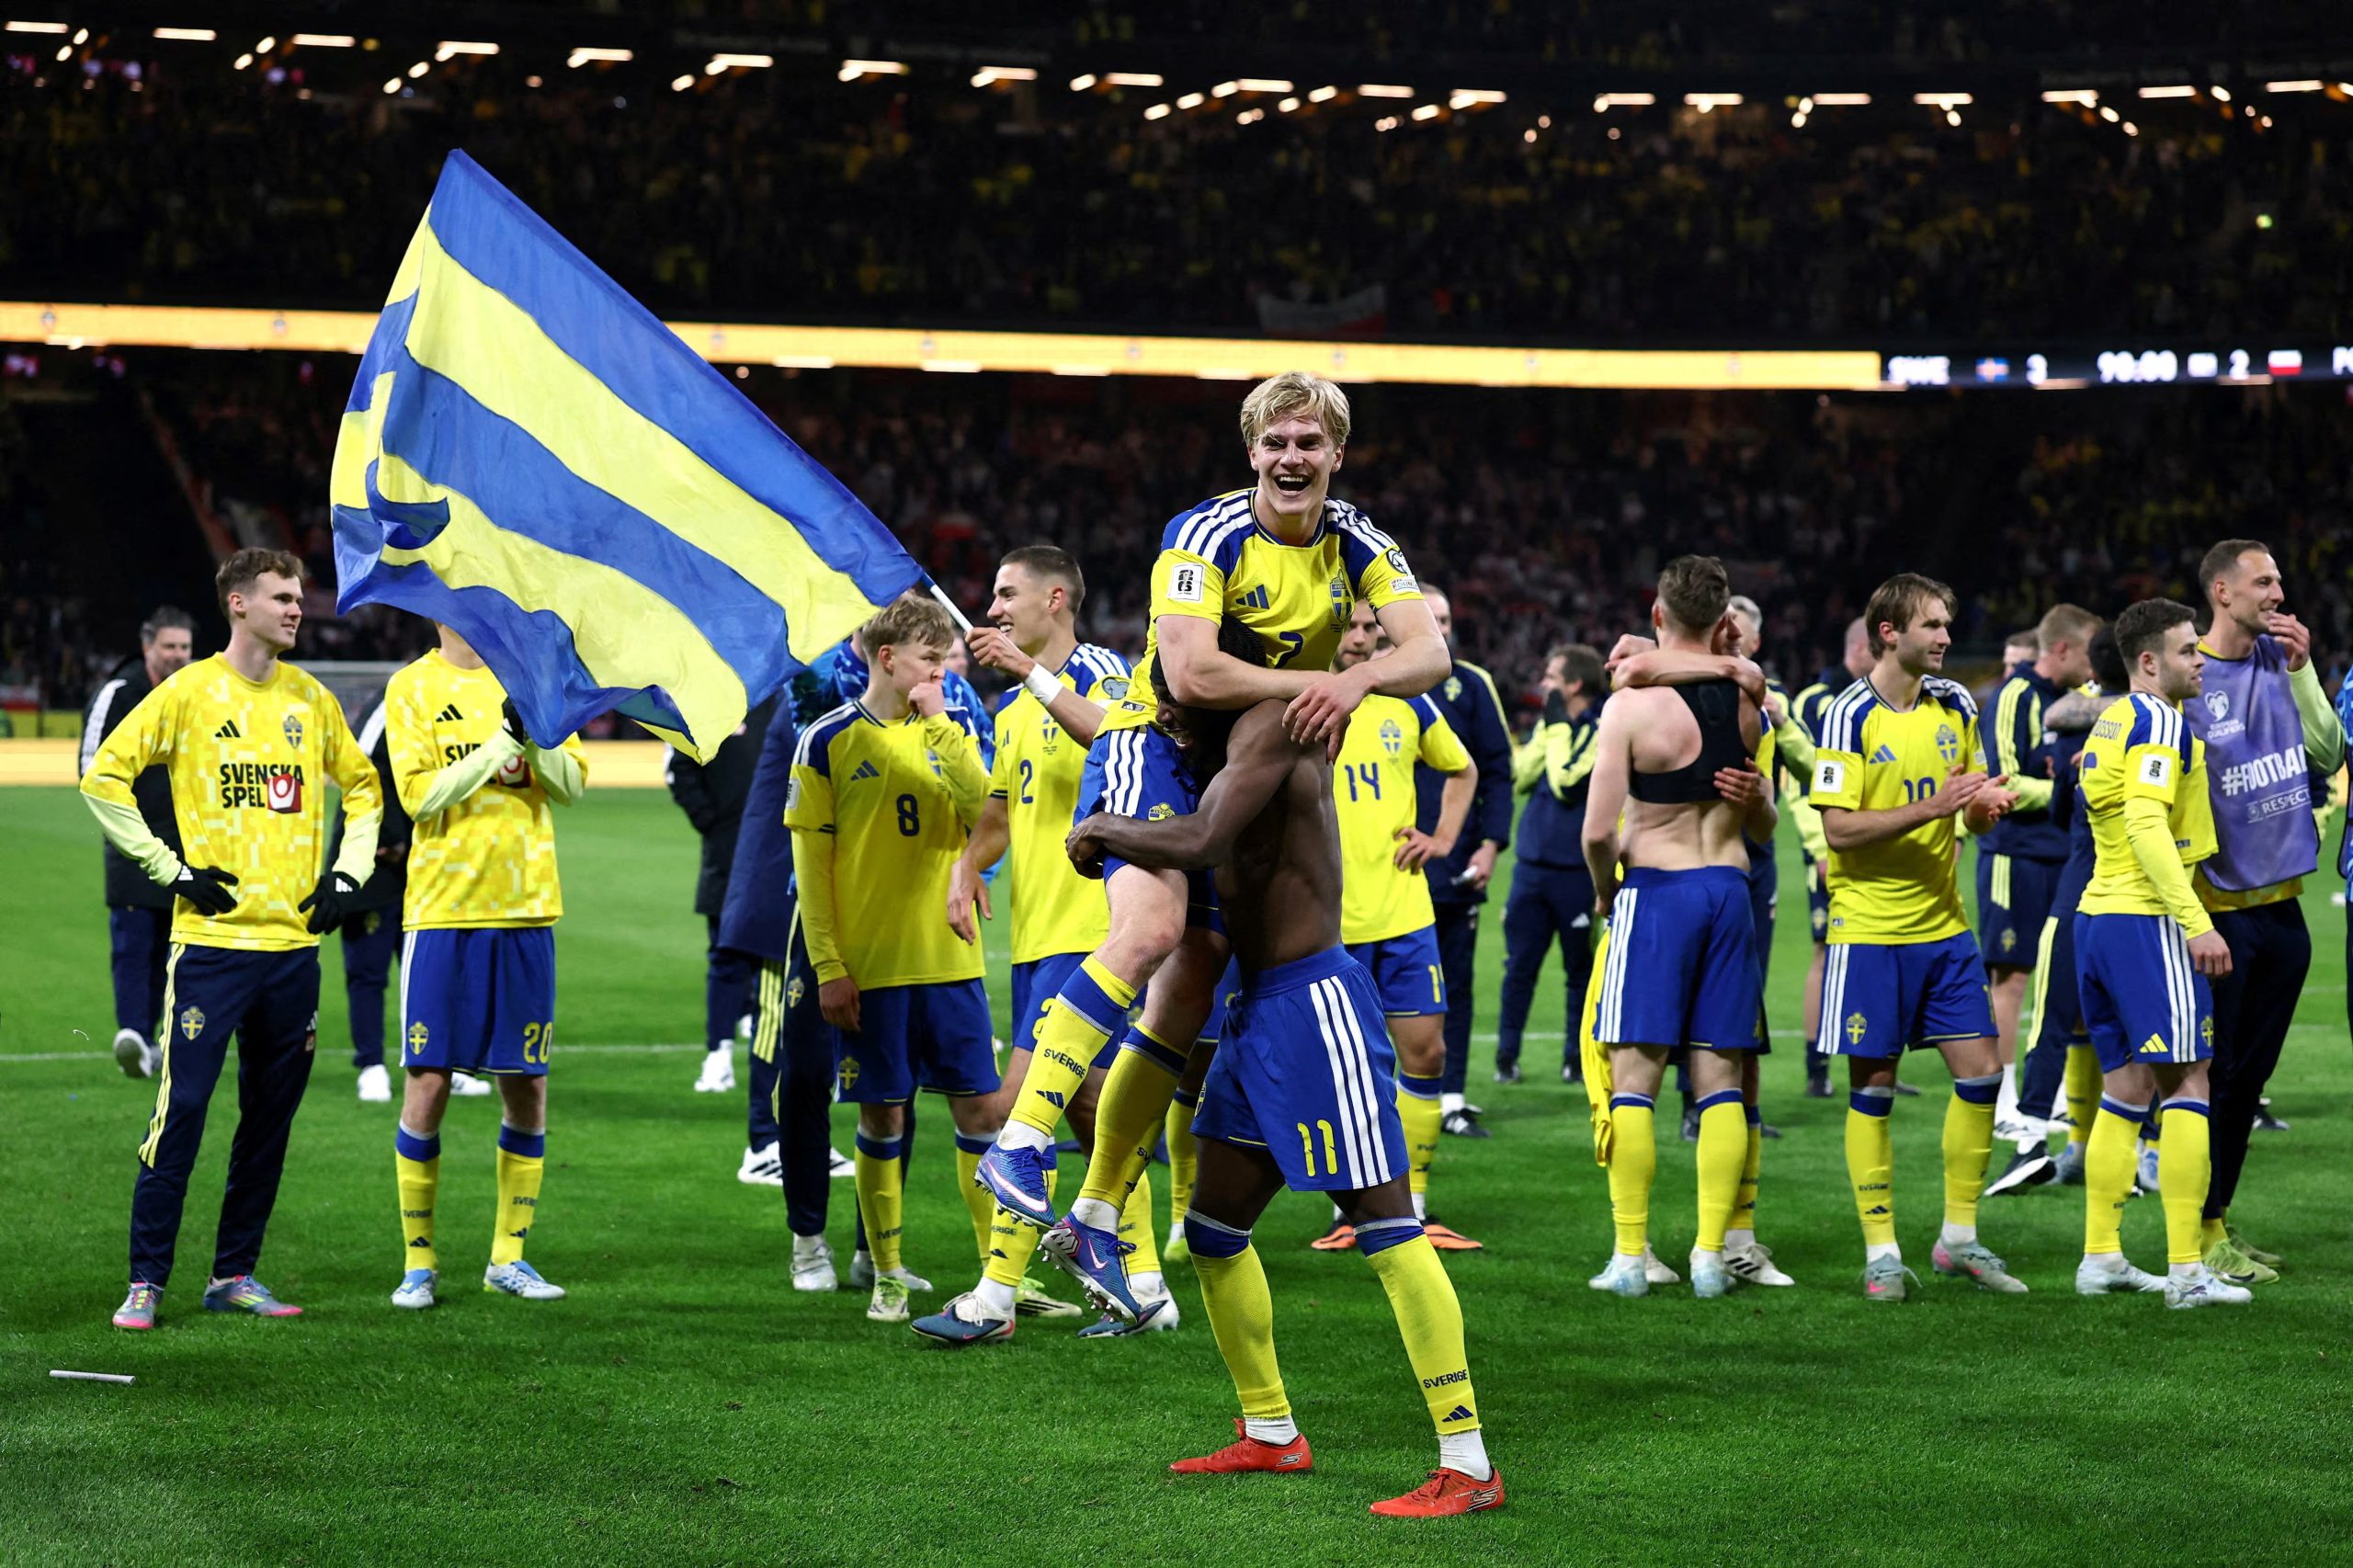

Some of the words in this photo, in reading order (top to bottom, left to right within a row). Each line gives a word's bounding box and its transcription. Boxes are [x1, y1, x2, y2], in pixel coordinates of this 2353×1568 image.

[222, 786, 266, 809] SPEL
[1019, 759, 1034, 804] 2
[1345, 762, 1381, 802] 14
[896, 793, 920, 836] 8
[524, 1021, 552, 1063] 20
[1044, 1048, 1086, 1079] SVERIGE
[1297, 1119, 1337, 1176] 11
[1423, 1369, 1468, 1389] SVERIGE
